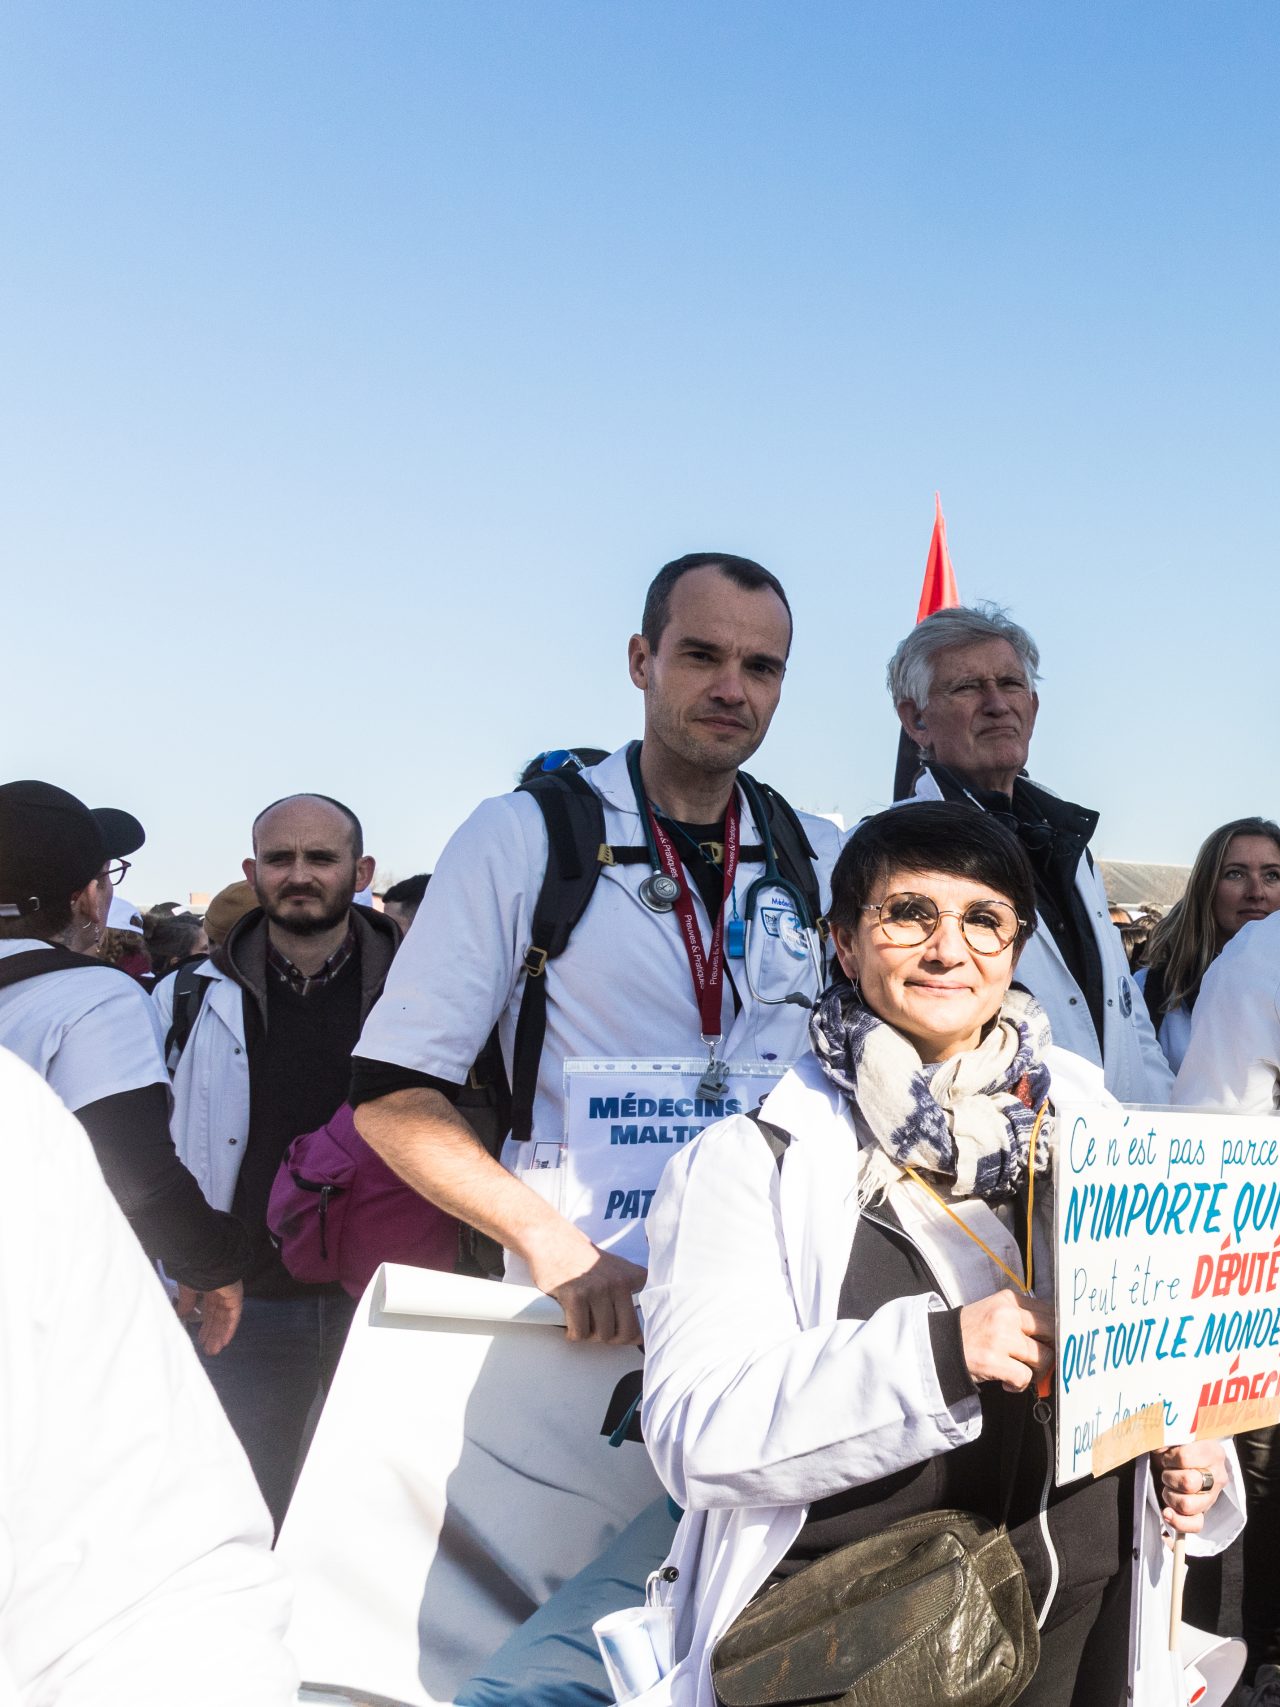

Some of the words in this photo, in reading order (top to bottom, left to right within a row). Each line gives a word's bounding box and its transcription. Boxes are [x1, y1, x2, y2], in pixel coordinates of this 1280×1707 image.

[684, 914, 697, 945] Preuves
[709, 956, 719, 985] Preuves
[589, 1092, 742, 1119] MÉDECINS
[1070, 1117, 1096, 1174] Ce
[1106, 1116, 1157, 1167] n'est
[1167, 1139, 1205, 1180] pas
[1220, 1139, 1278, 1179] parce
[1064, 1182, 1228, 1244] N'IMPORTE
[1073, 1259, 1119, 1316] Peut
[1128, 1256, 1181, 1306] être
[1062, 1329, 1099, 1394] QUE
[1103, 1319, 1156, 1372] TOUT
[1155, 1315, 1194, 1360] LE
